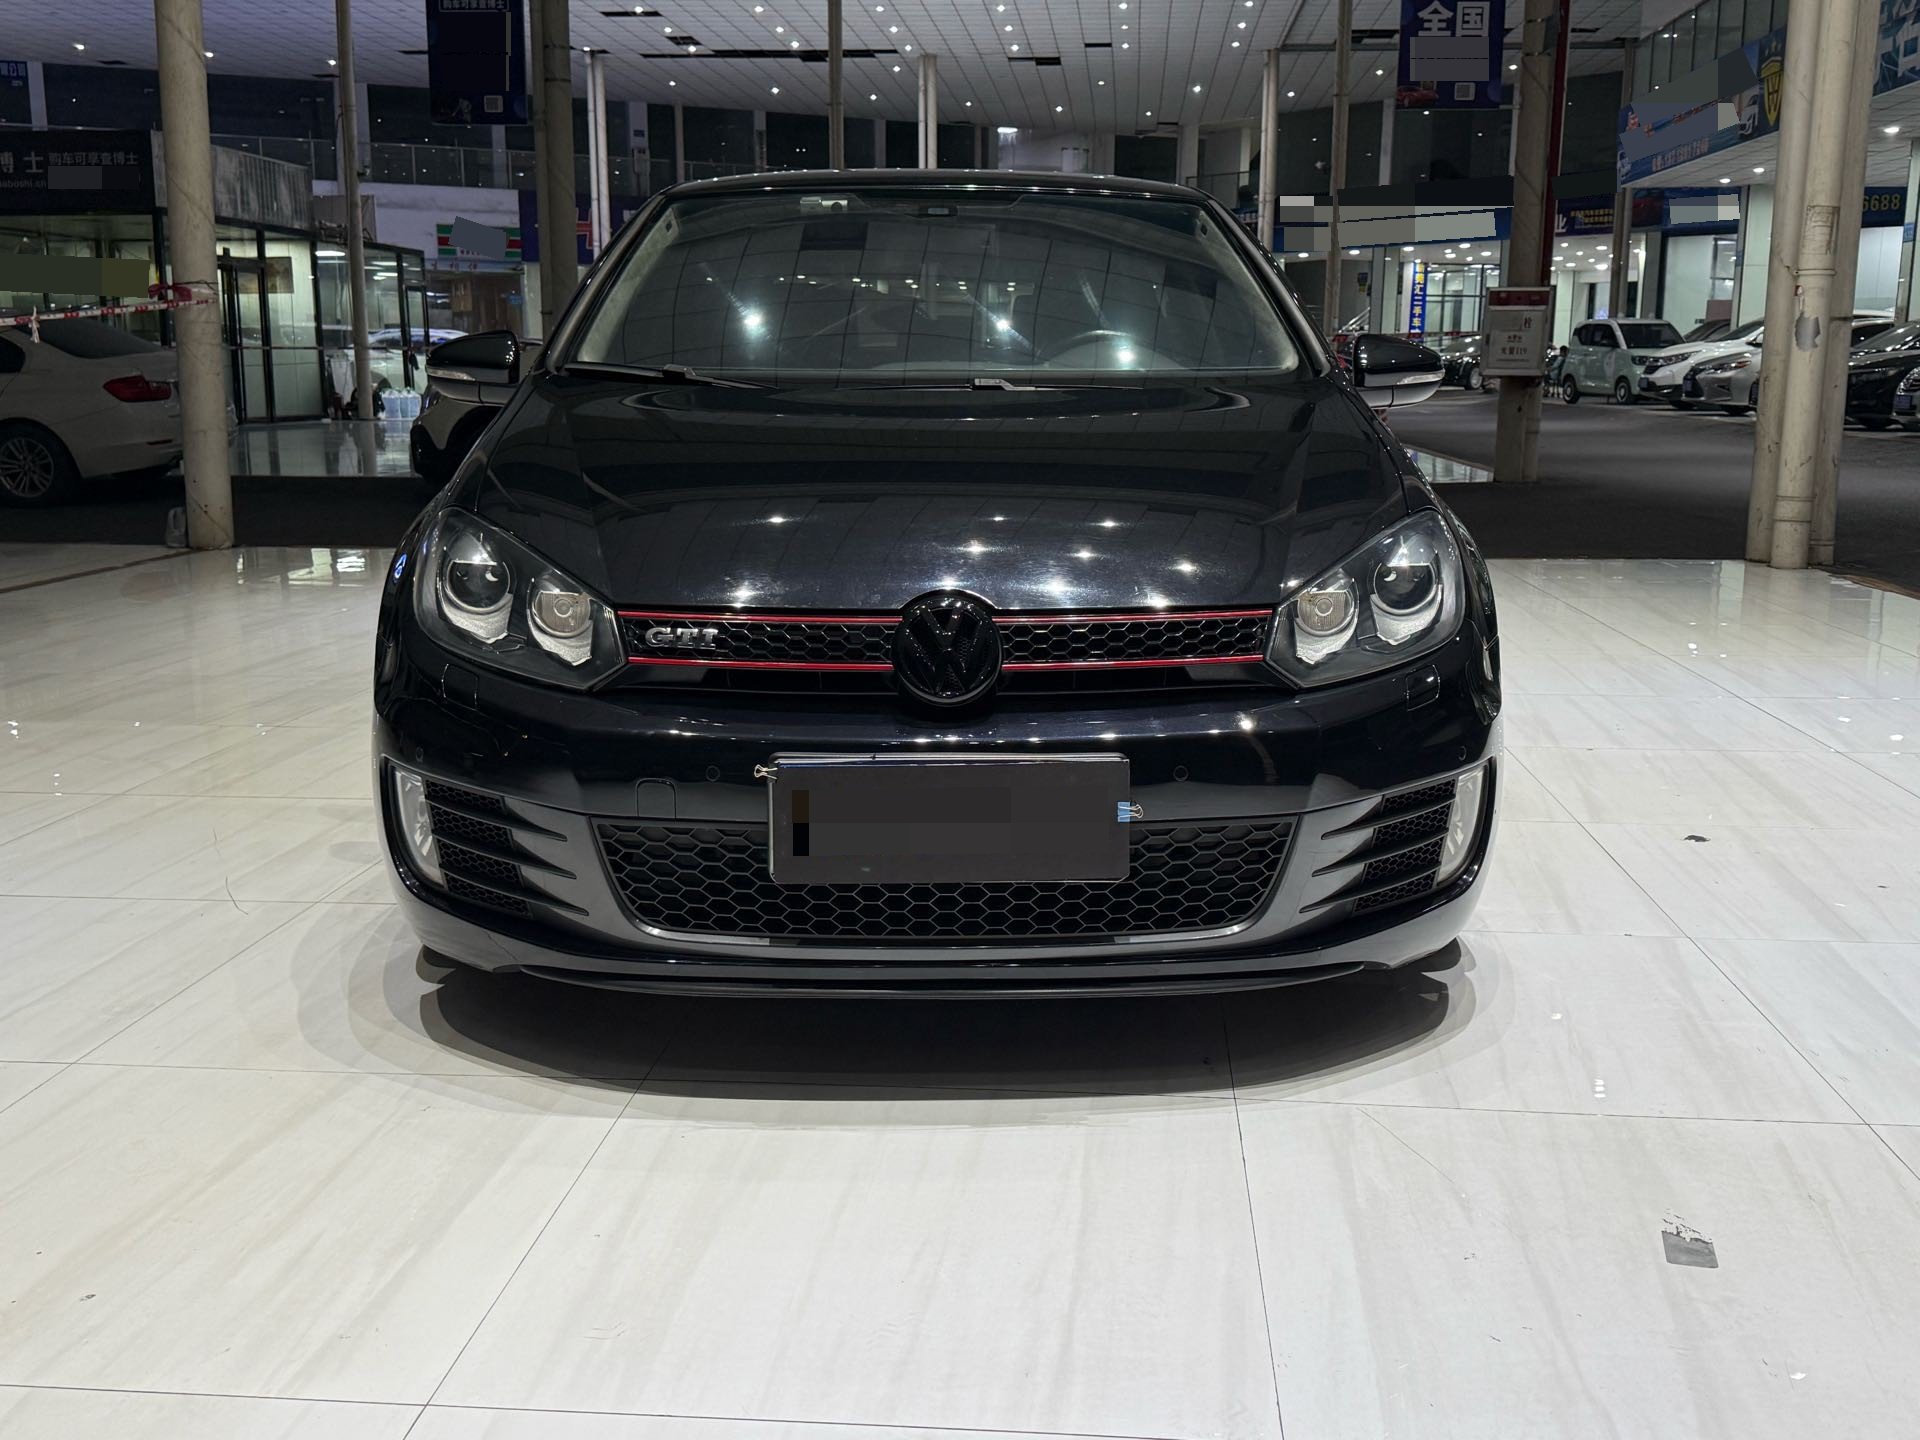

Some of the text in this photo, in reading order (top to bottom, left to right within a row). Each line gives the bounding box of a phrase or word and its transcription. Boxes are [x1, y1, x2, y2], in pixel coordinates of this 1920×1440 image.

[1417, 0, 1490, 37] 全国
[48, 151, 139, 166] 购车可享查博士
[644, 626, 720, 651] GTI
